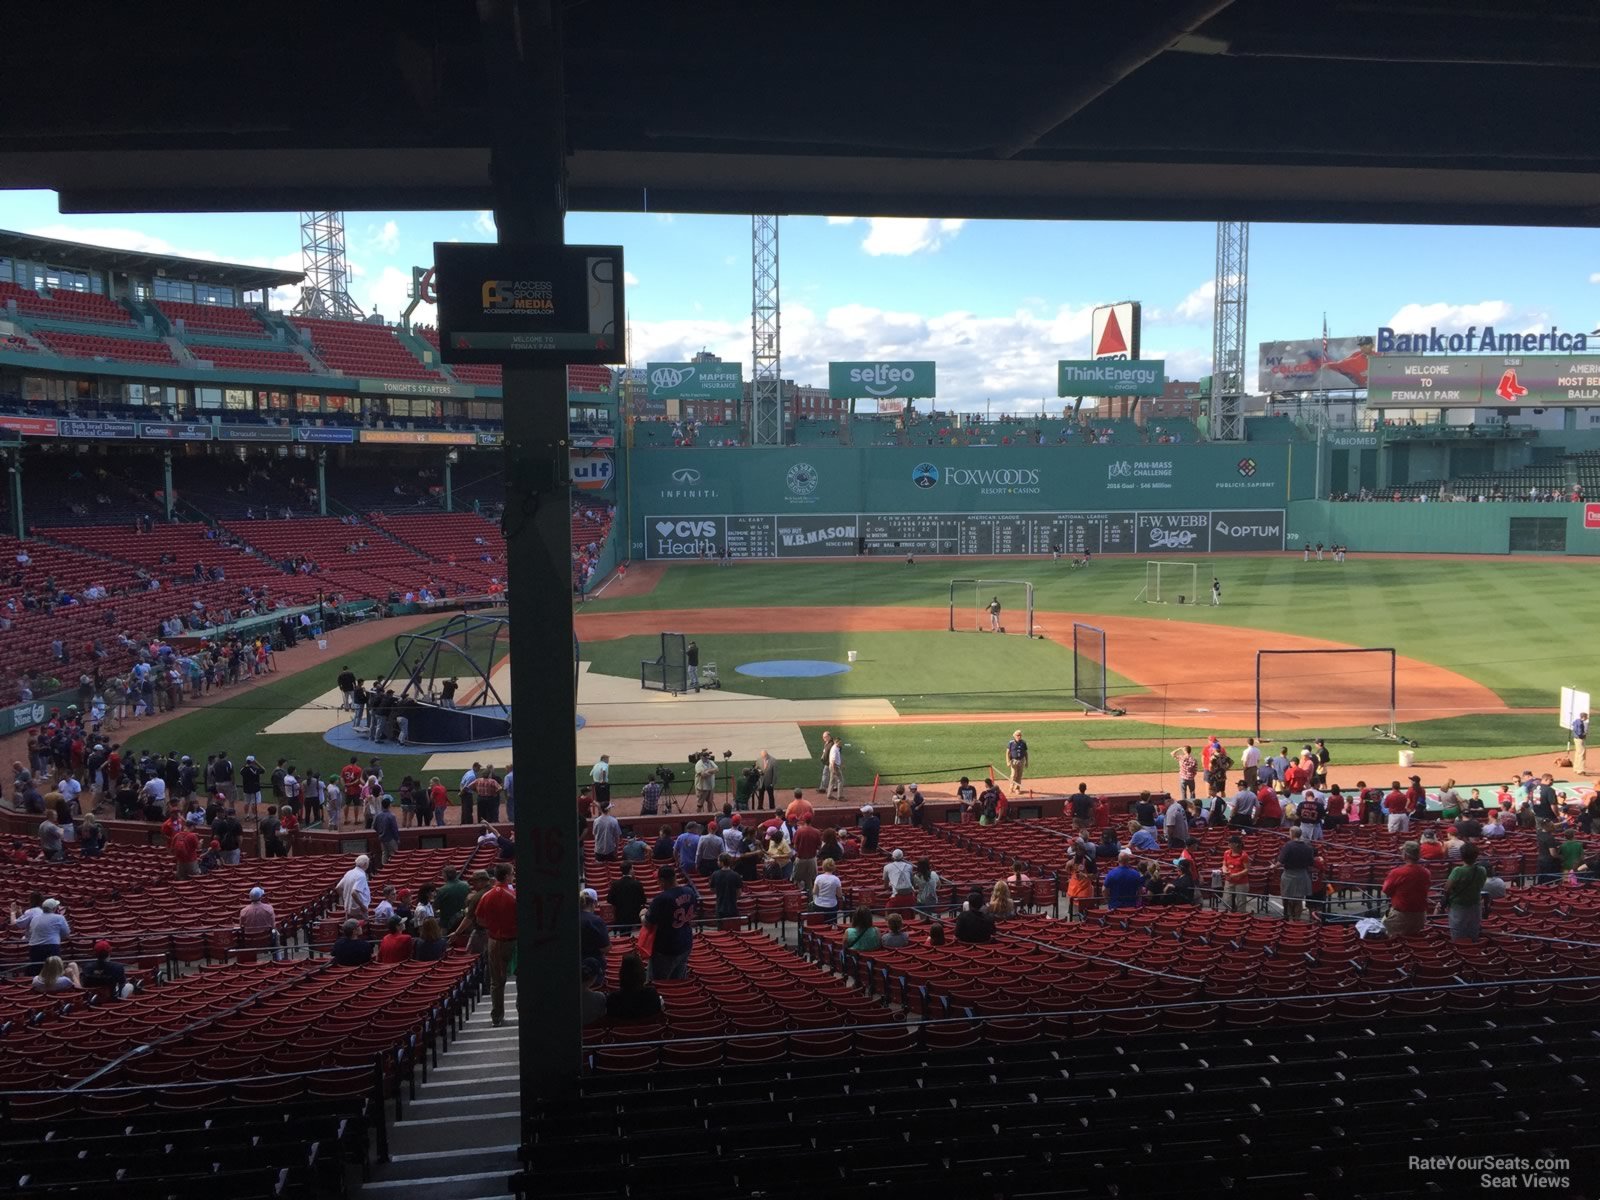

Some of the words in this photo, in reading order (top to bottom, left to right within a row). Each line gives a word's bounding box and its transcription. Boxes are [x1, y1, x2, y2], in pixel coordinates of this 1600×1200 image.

[514, 281, 552, 290] ACCESS
[514, 290, 552, 299] SPORTS
[514, 299, 554, 308] MEDIA
[1377, 327, 1444, 352] Bank
[1448, 327, 1476, 352] of
[1479, 327, 1588, 352] America
[1405, 365, 1449, 375] WELCOME
[655, 368, 679, 388] AAA
[699, 373, 739, 381] MAPFRE
[1558, 377, 1583, 386] MOST
[1587, 377, 1600, 386] BE
[1420, 378, 1433, 387] TO
[383, 383, 417, 393] TONIGHT'S
[418, 385, 452, 394] STARTERS
[1391, 390, 1431, 400] FENWAY
[1434, 390, 1460, 400] PARK
[1568, 389, 1600, 399] BALLP
[574, 462, 610, 478] ulf
[1133, 461, 1173, 469] PAN-MASS
[944, 467, 1040, 486] FOXWOODS
[1133, 469, 1173, 477] CHALLENGE
[661, 490, 717, 498] INFINITI
[1167, 515, 1207, 527] WEBB
[675, 521, 716, 538] CVS
[1231, 526, 1279, 537] OPTUM
[657, 538, 717, 555] Health
